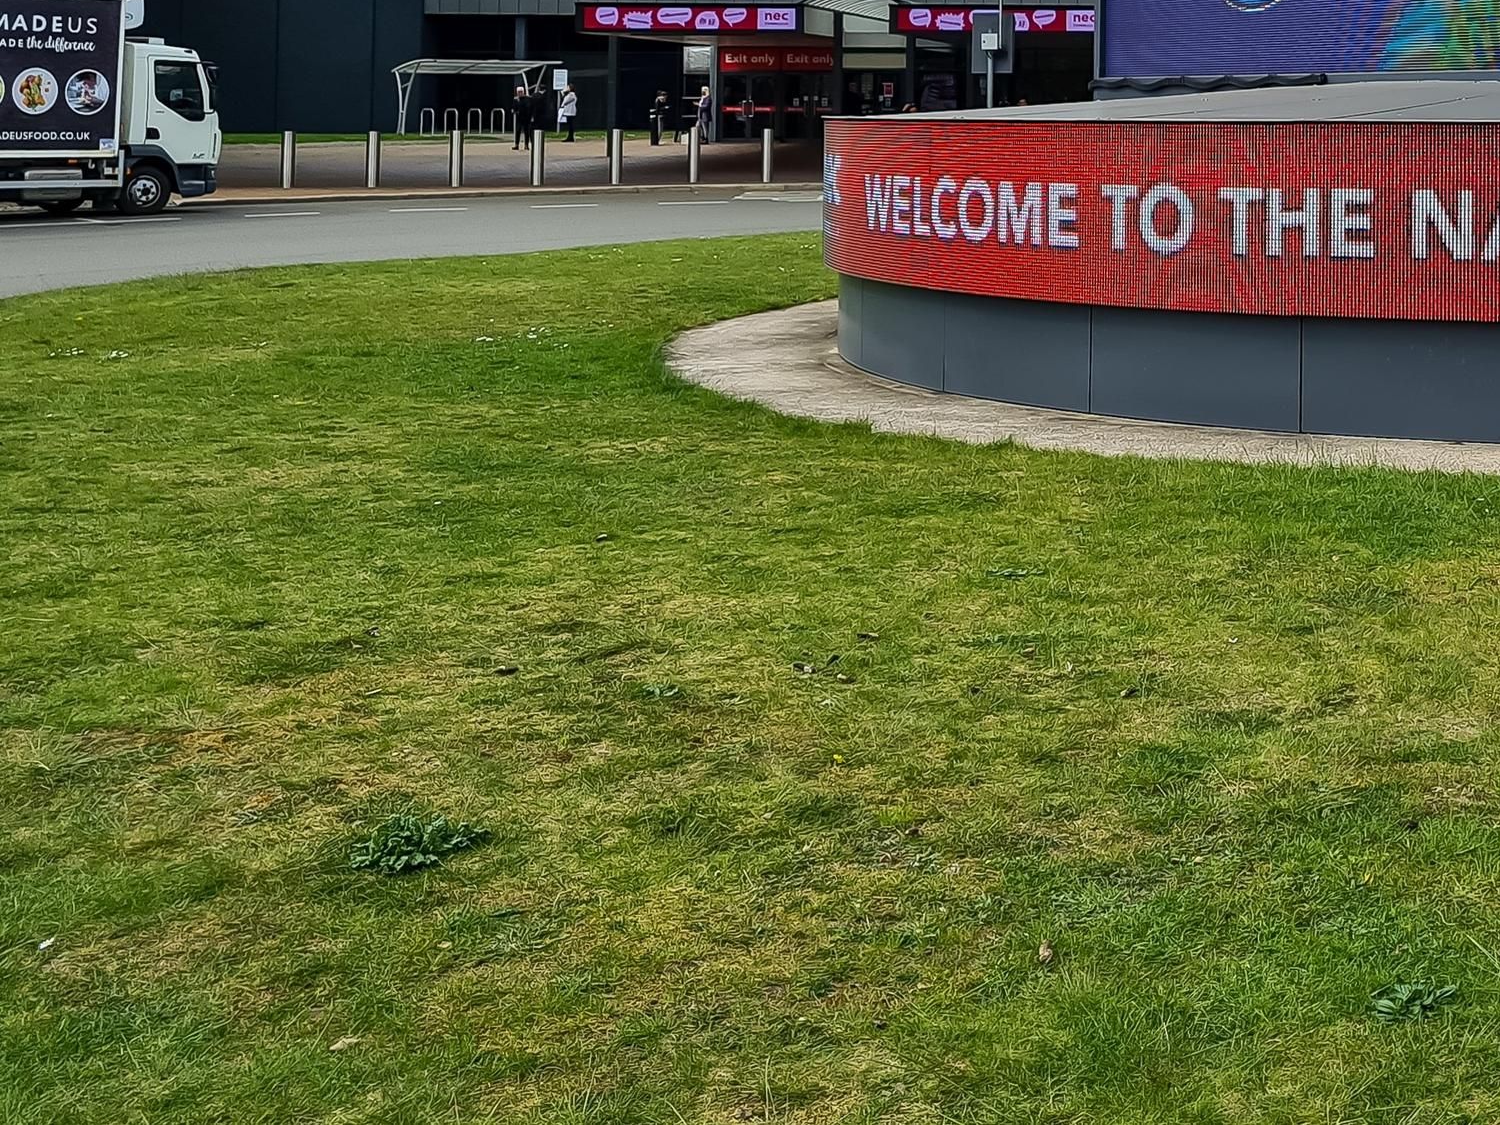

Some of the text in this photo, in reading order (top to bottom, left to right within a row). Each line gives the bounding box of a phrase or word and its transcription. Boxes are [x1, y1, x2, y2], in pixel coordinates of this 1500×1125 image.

[764, 12, 789, 21] nec
[1073, 14, 1095, 23] nec
[26, 35, 43, 50] the
[44, 35, 96, 52] difference
[724, 53, 775, 66] Exit only
[786, 54, 834, 66] Exit only
[864, 174, 1080, 250] WELCOME
[1102, 183, 1195, 255] TO
[1219, 187, 1376, 259] THE
